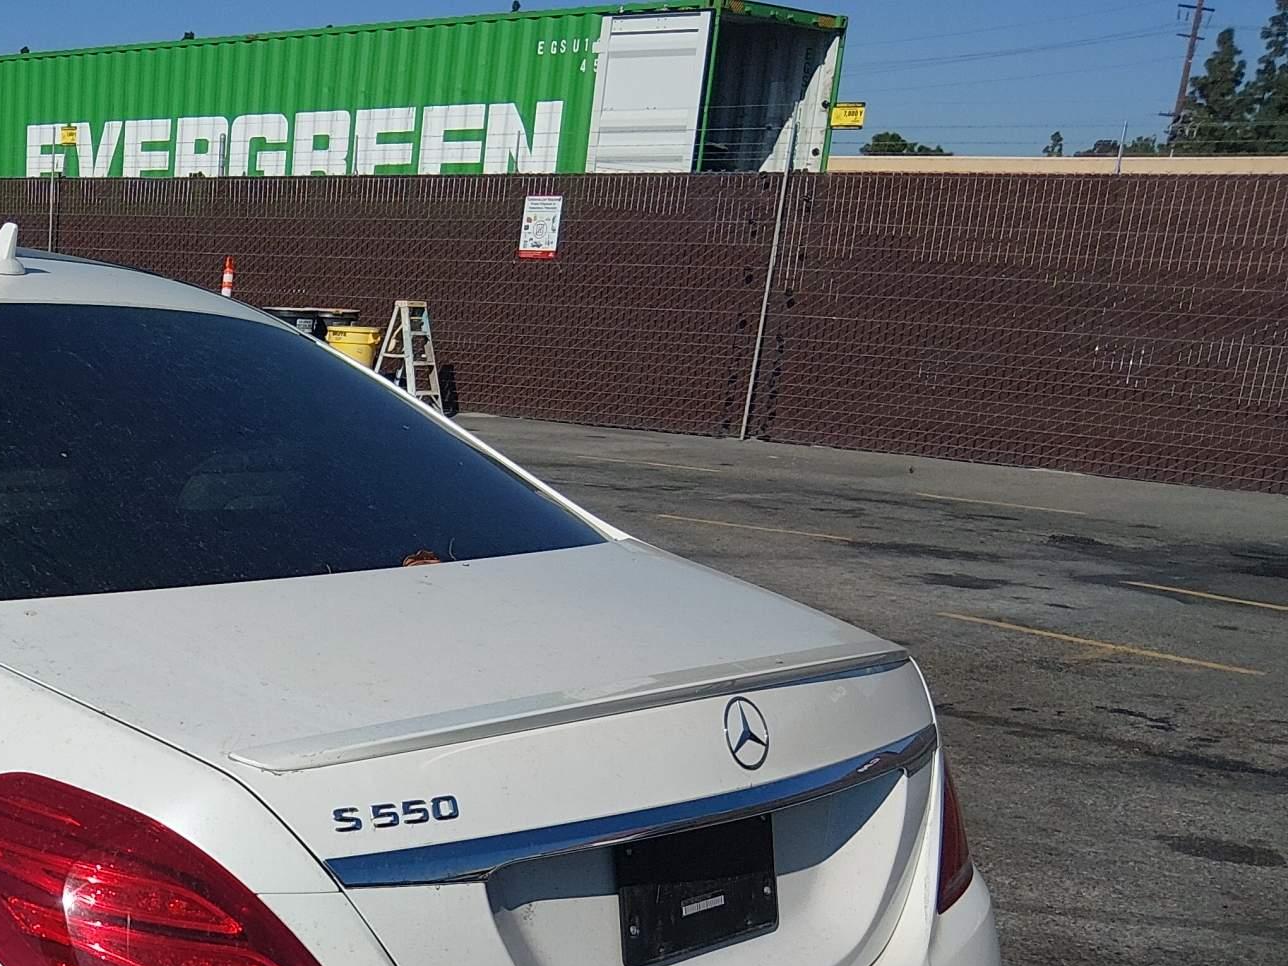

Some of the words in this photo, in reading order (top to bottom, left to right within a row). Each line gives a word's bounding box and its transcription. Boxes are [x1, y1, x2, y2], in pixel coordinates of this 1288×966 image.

[26, 100, 564, 177] EVERGREEN
[332, 807, 363, 832] S
[370, 795, 460, 828] 550
